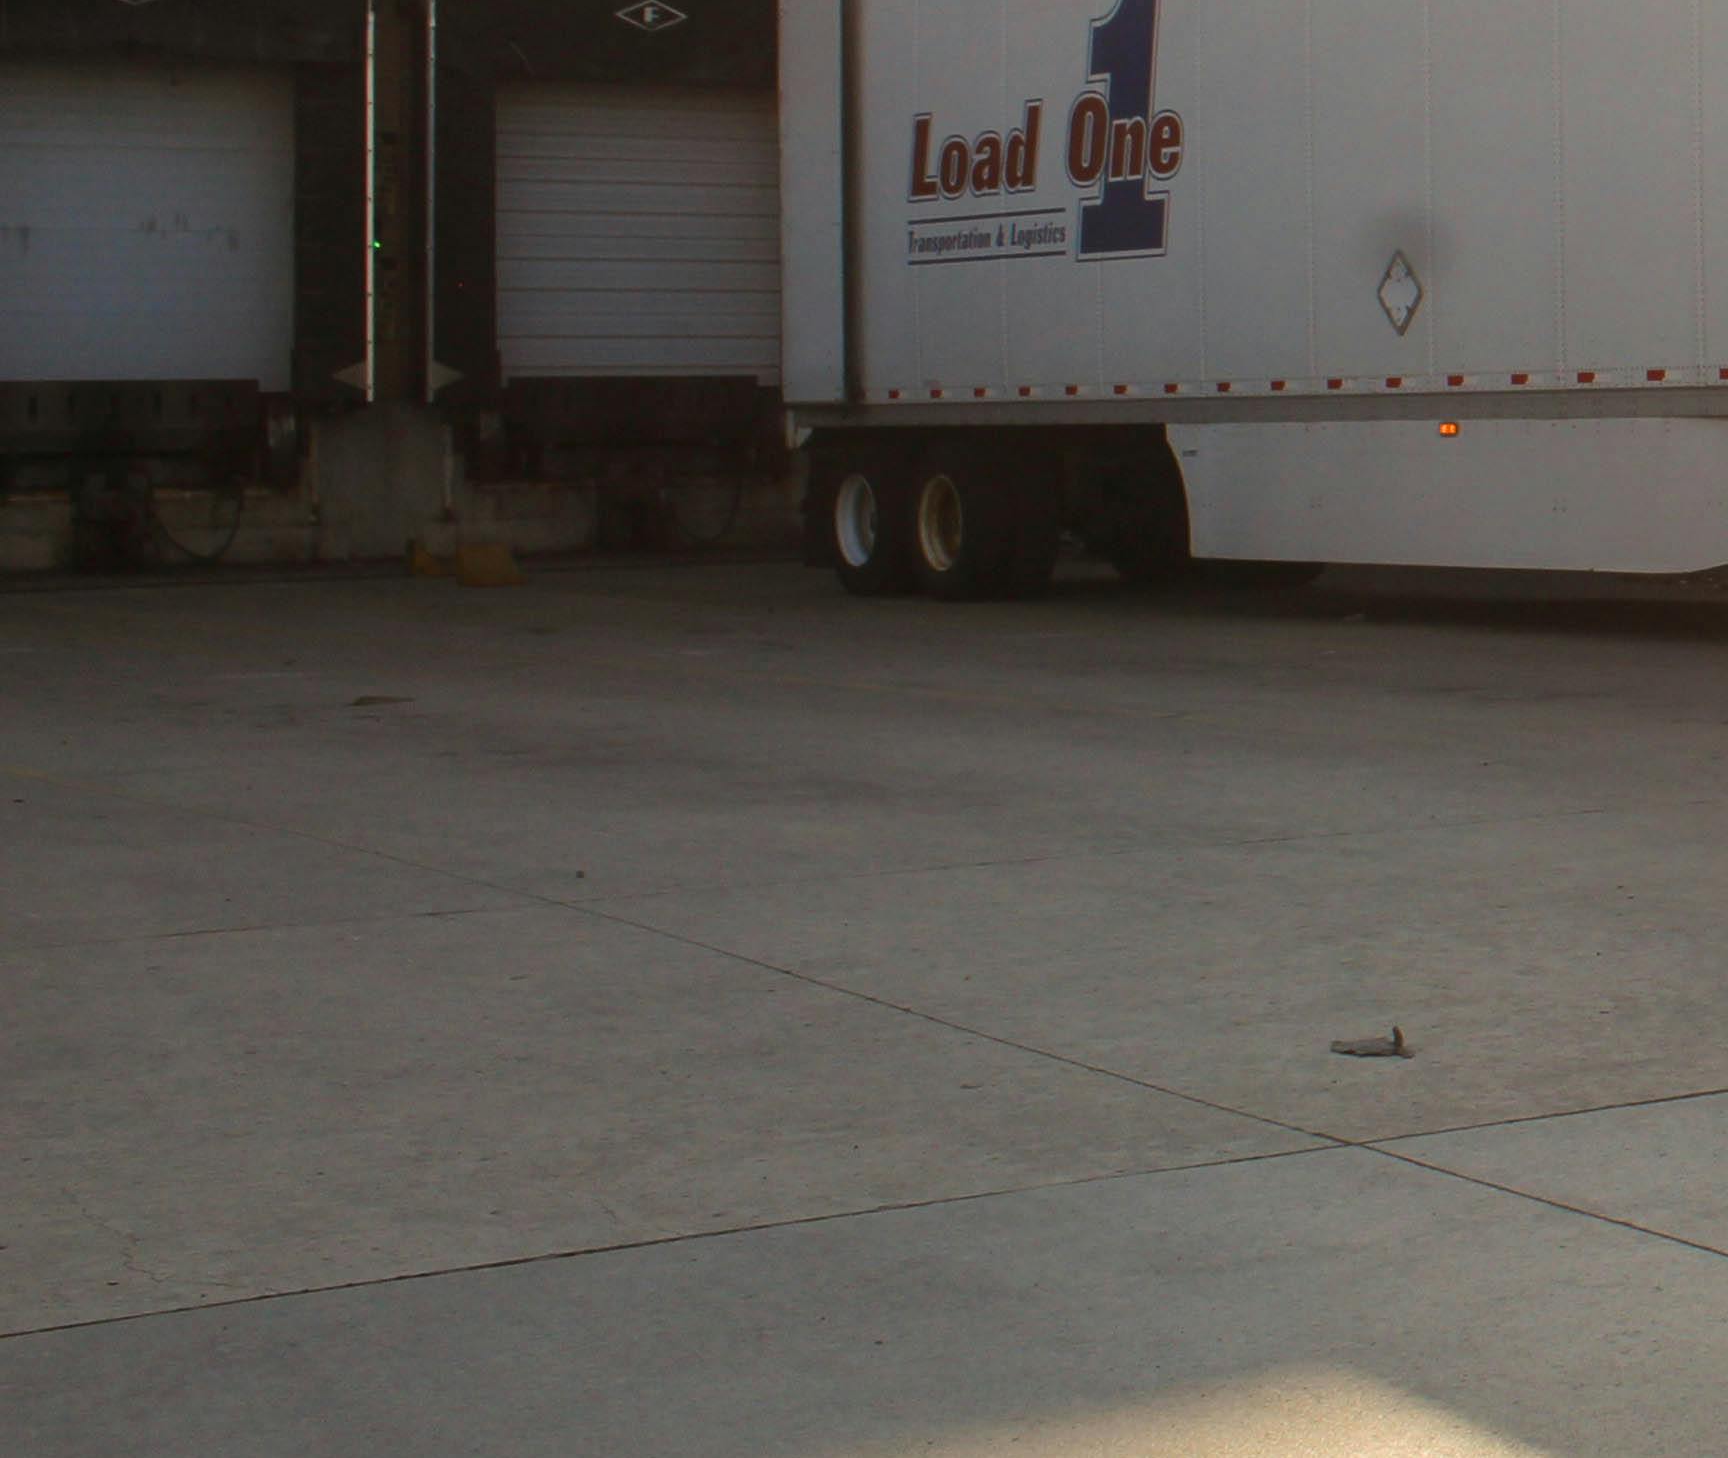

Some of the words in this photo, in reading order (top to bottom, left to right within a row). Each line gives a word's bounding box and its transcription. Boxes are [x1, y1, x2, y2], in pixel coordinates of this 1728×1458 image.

[908, 98, 1043, 202] Load
[1066, 91, 1184, 188] One
[908, 229, 991, 254] Transportation
[996, 223, 1004, 247] &
[1010, 222, 1066, 250] Logistics
